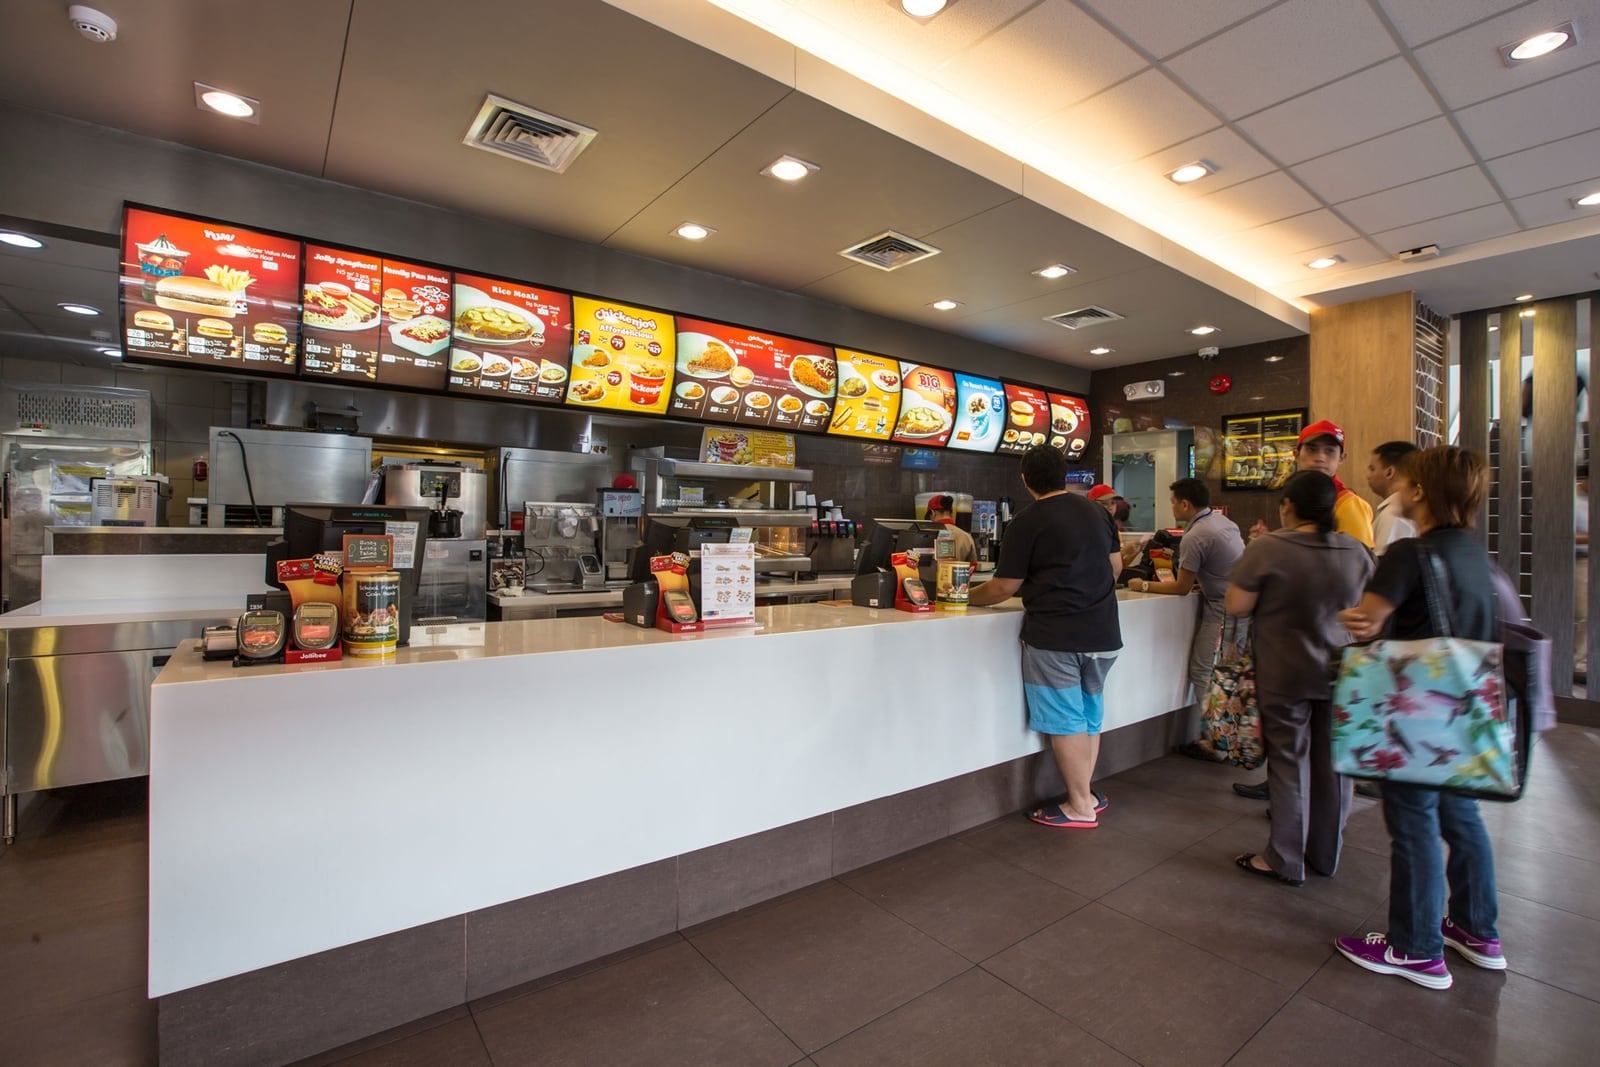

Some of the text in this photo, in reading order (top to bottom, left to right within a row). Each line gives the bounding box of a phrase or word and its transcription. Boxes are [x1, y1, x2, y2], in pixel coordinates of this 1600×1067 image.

[203, 230, 235, 241] YUM!
[314, 253, 378, 271] Jolly Spaghetti
[383, 266, 449, 284] Family Pan Meals
[491, 286, 539, 301] Rice Meals
[595, 308, 657, 331] Chickenjoy
[599, 324, 654, 340] Affordelicious
[919, 374, 939, 388] BIG
[300, 652, 327, 660] Jollibee
